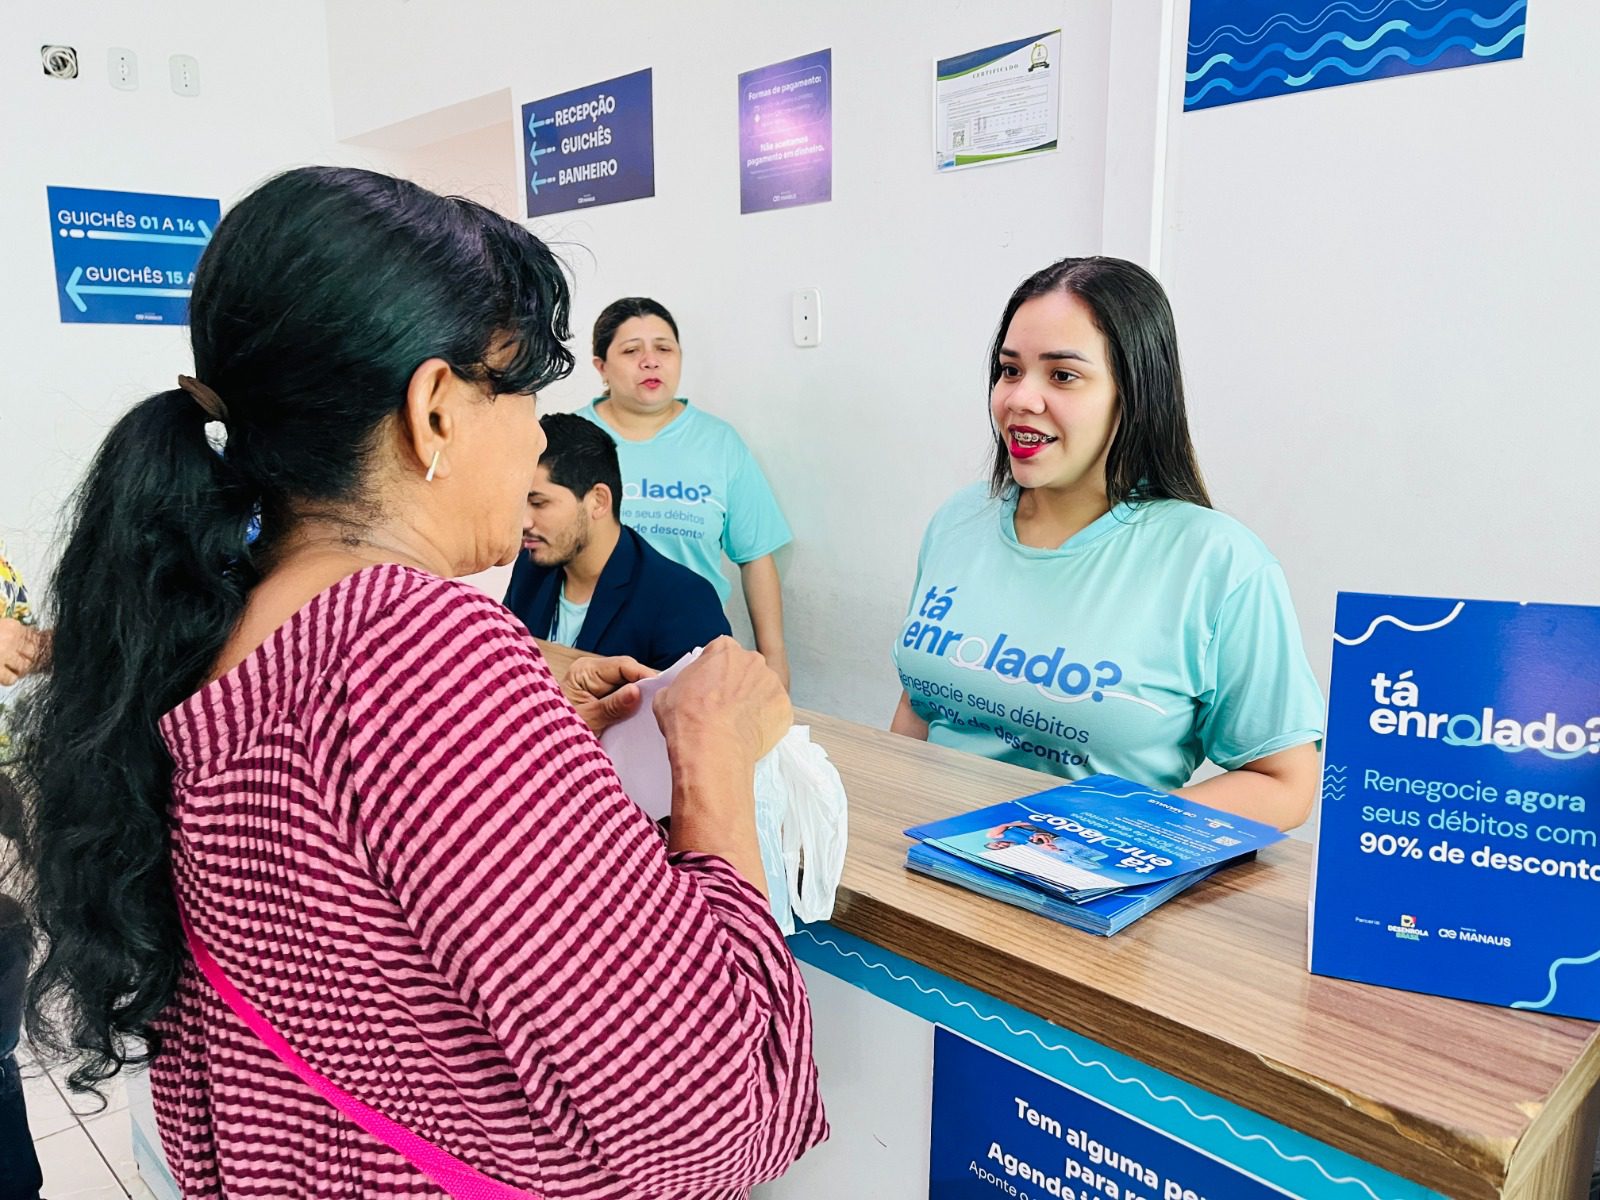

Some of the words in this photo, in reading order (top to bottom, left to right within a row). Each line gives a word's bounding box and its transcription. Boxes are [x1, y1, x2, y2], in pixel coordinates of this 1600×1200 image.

[972, 64, 1019, 79] CERTIFICADO
[748, 89, 772, 101] Formas
[772, 86, 781, 95] de
[781, 75, 822, 93] pagamento:
[555, 94, 616, 127] RECEPÇÃO
[561, 125, 612, 154] GUICHÊS
[559, 159, 618, 186] BANHEIRO
[747, 152, 783, 168] pagamento
[783, 150, 794, 159] em
[57, 209, 136, 229] GUICHÊS
[140, 215, 159, 230] 01
[162, 217, 175, 231] A
[177, 218, 195, 232] 14
[86, 265, 163, 284] GUICHÊS
[166, 271, 184, 285] 15
[635, 510, 662, 519] seus
[664, 510, 705, 525] débitos
[919, 585, 958, 621] tá
[903, 620, 1123, 703] enrolado?
[1369, 670, 1419, 707] tá
[967, 692, 1005, 717] seus
[1010, 706, 1089, 743] débitos
[994, 724, 1089, 767] desconto!
[1147, 798, 1183, 813] MANAUS
[1364, 769, 1498, 802] Renegocie
[1505, 788, 1586, 813] agora
[1028, 813, 1173, 867] enrolado?
[1361, 804, 1420, 827] seus
[1428, 810, 1528, 839] débitos
[1536, 823, 1597, 847] com
[1360, 832, 1423, 860] 90%
[1428, 841, 1465, 864] de
[1115, 857, 1156, 873] tá
[1387, 925, 1429, 937] DESENROLA
[1460, 931, 1511, 947] MANAUS
[1014, 1097, 1061, 1138] Tem
[1066, 1128, 1158, 1190] alguma
[1164, 1179, 1206, 1200] pe
[968, 1161, 1017, 1197] Aponte
[988, 1142, 1076, 1200] Agende
[1065, 1157, 1119, 1200] para
